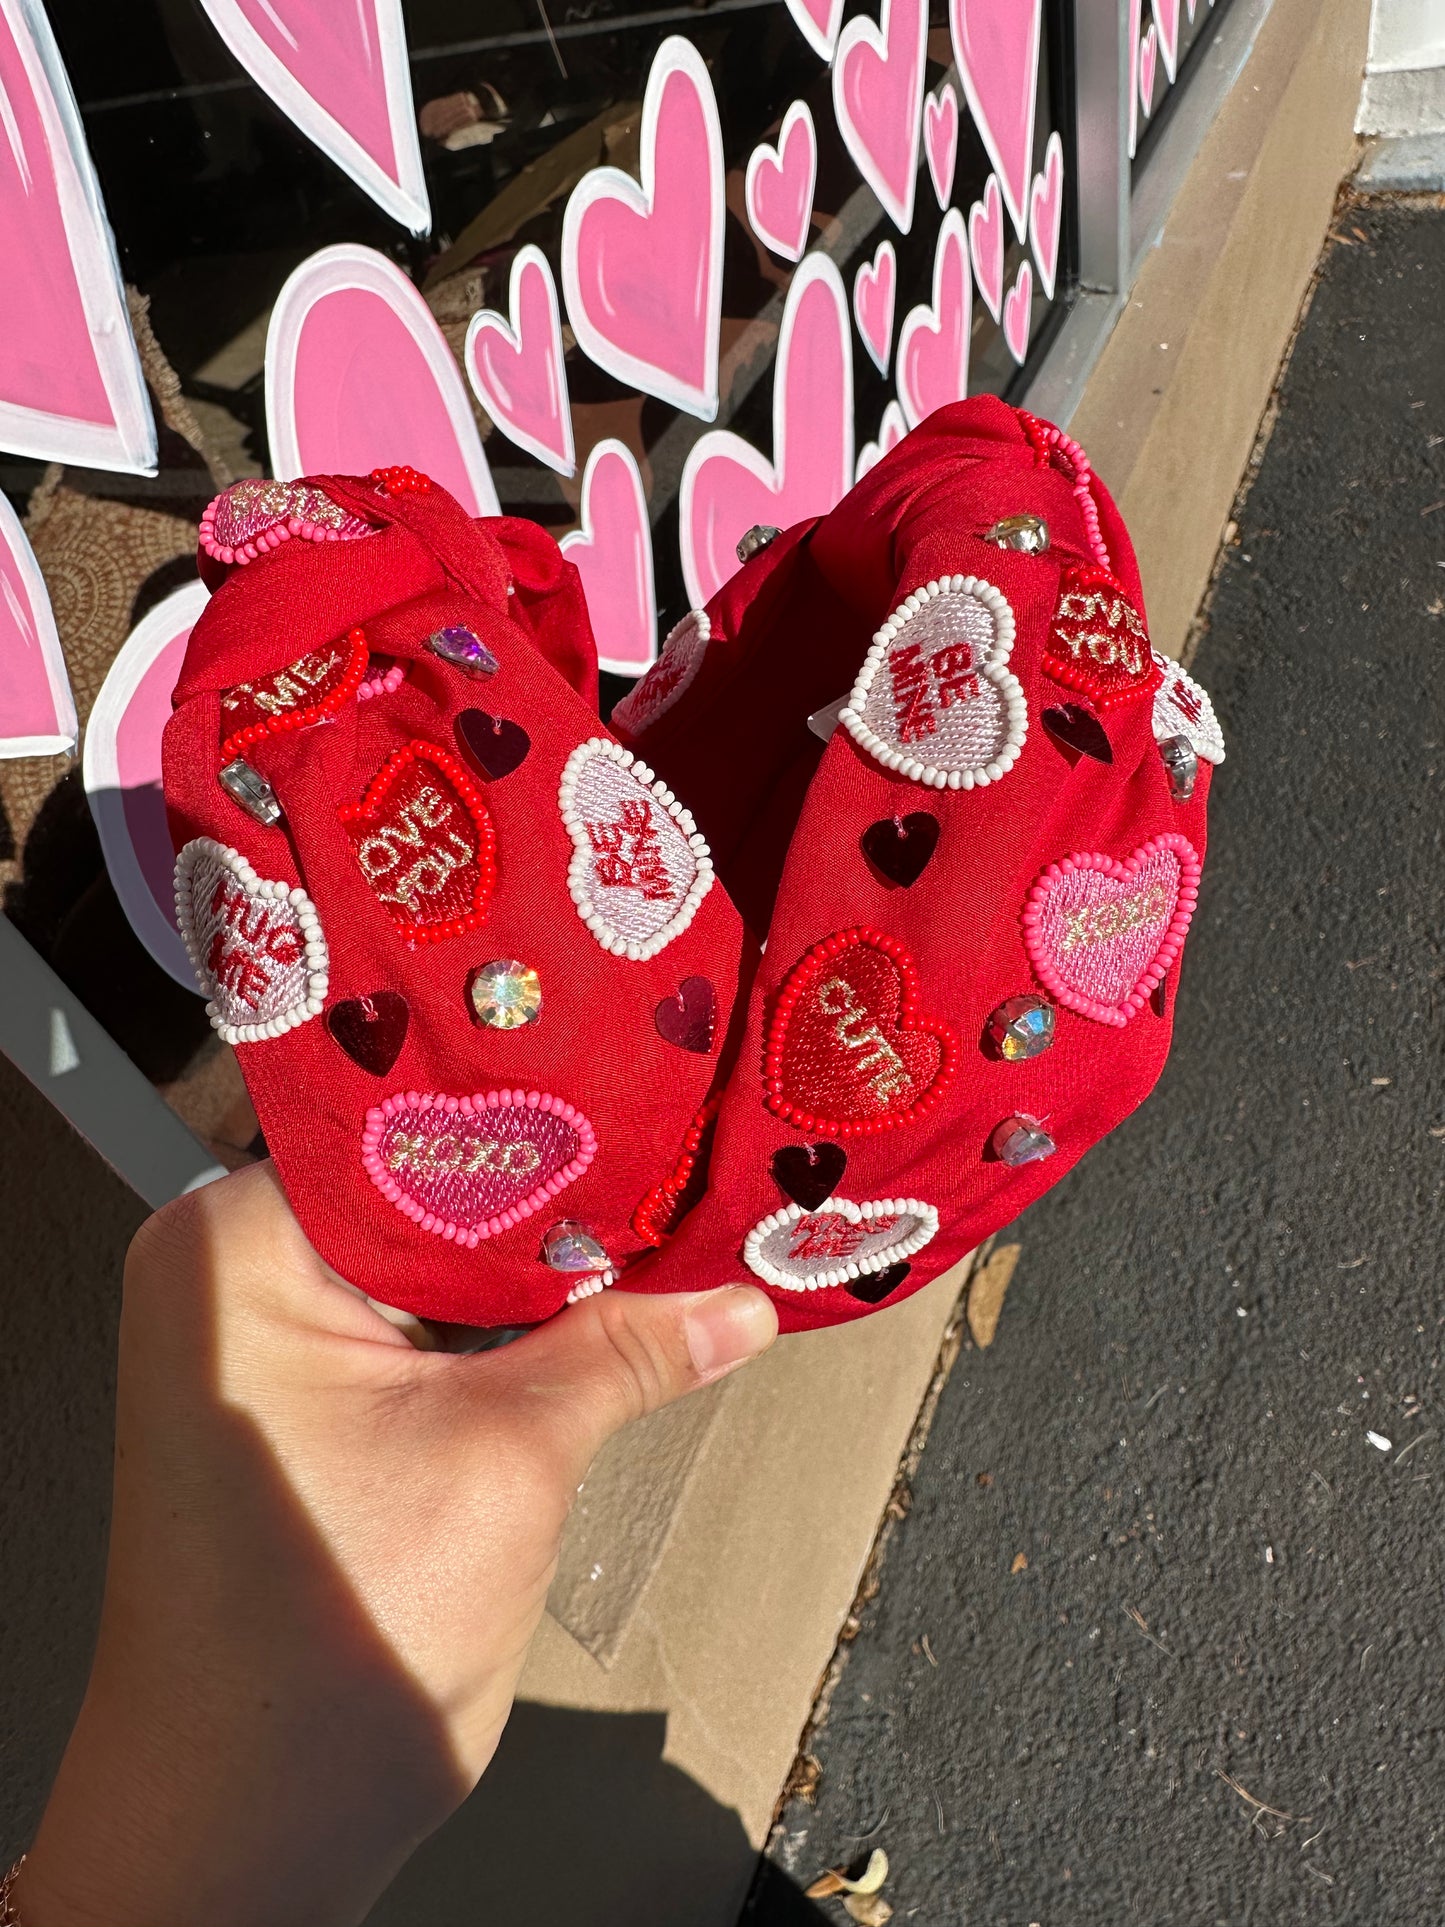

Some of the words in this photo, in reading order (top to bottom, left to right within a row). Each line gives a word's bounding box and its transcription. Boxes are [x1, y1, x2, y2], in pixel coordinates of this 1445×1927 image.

[1058, 591, 1148, 640] OVE
[930, 642, 980, 709] BE
[1056, 628, 1142, 675] YOU
[889, 642, 937, 743] MINE
[359, 786, 453, 878] OVE
[584, 822, 633, 888] BE
[377, 832, 473, 912] YOU
[212, 880, 306, 966] HUG
[1063, 885, 1166, 950] XOXO
[208, 931, 271, 1011] ME
[820, 977, 914, 1104] CUTE
[389, 1131, 541, 1174] XOXO
[788, 1230, 864, 1258] ME
